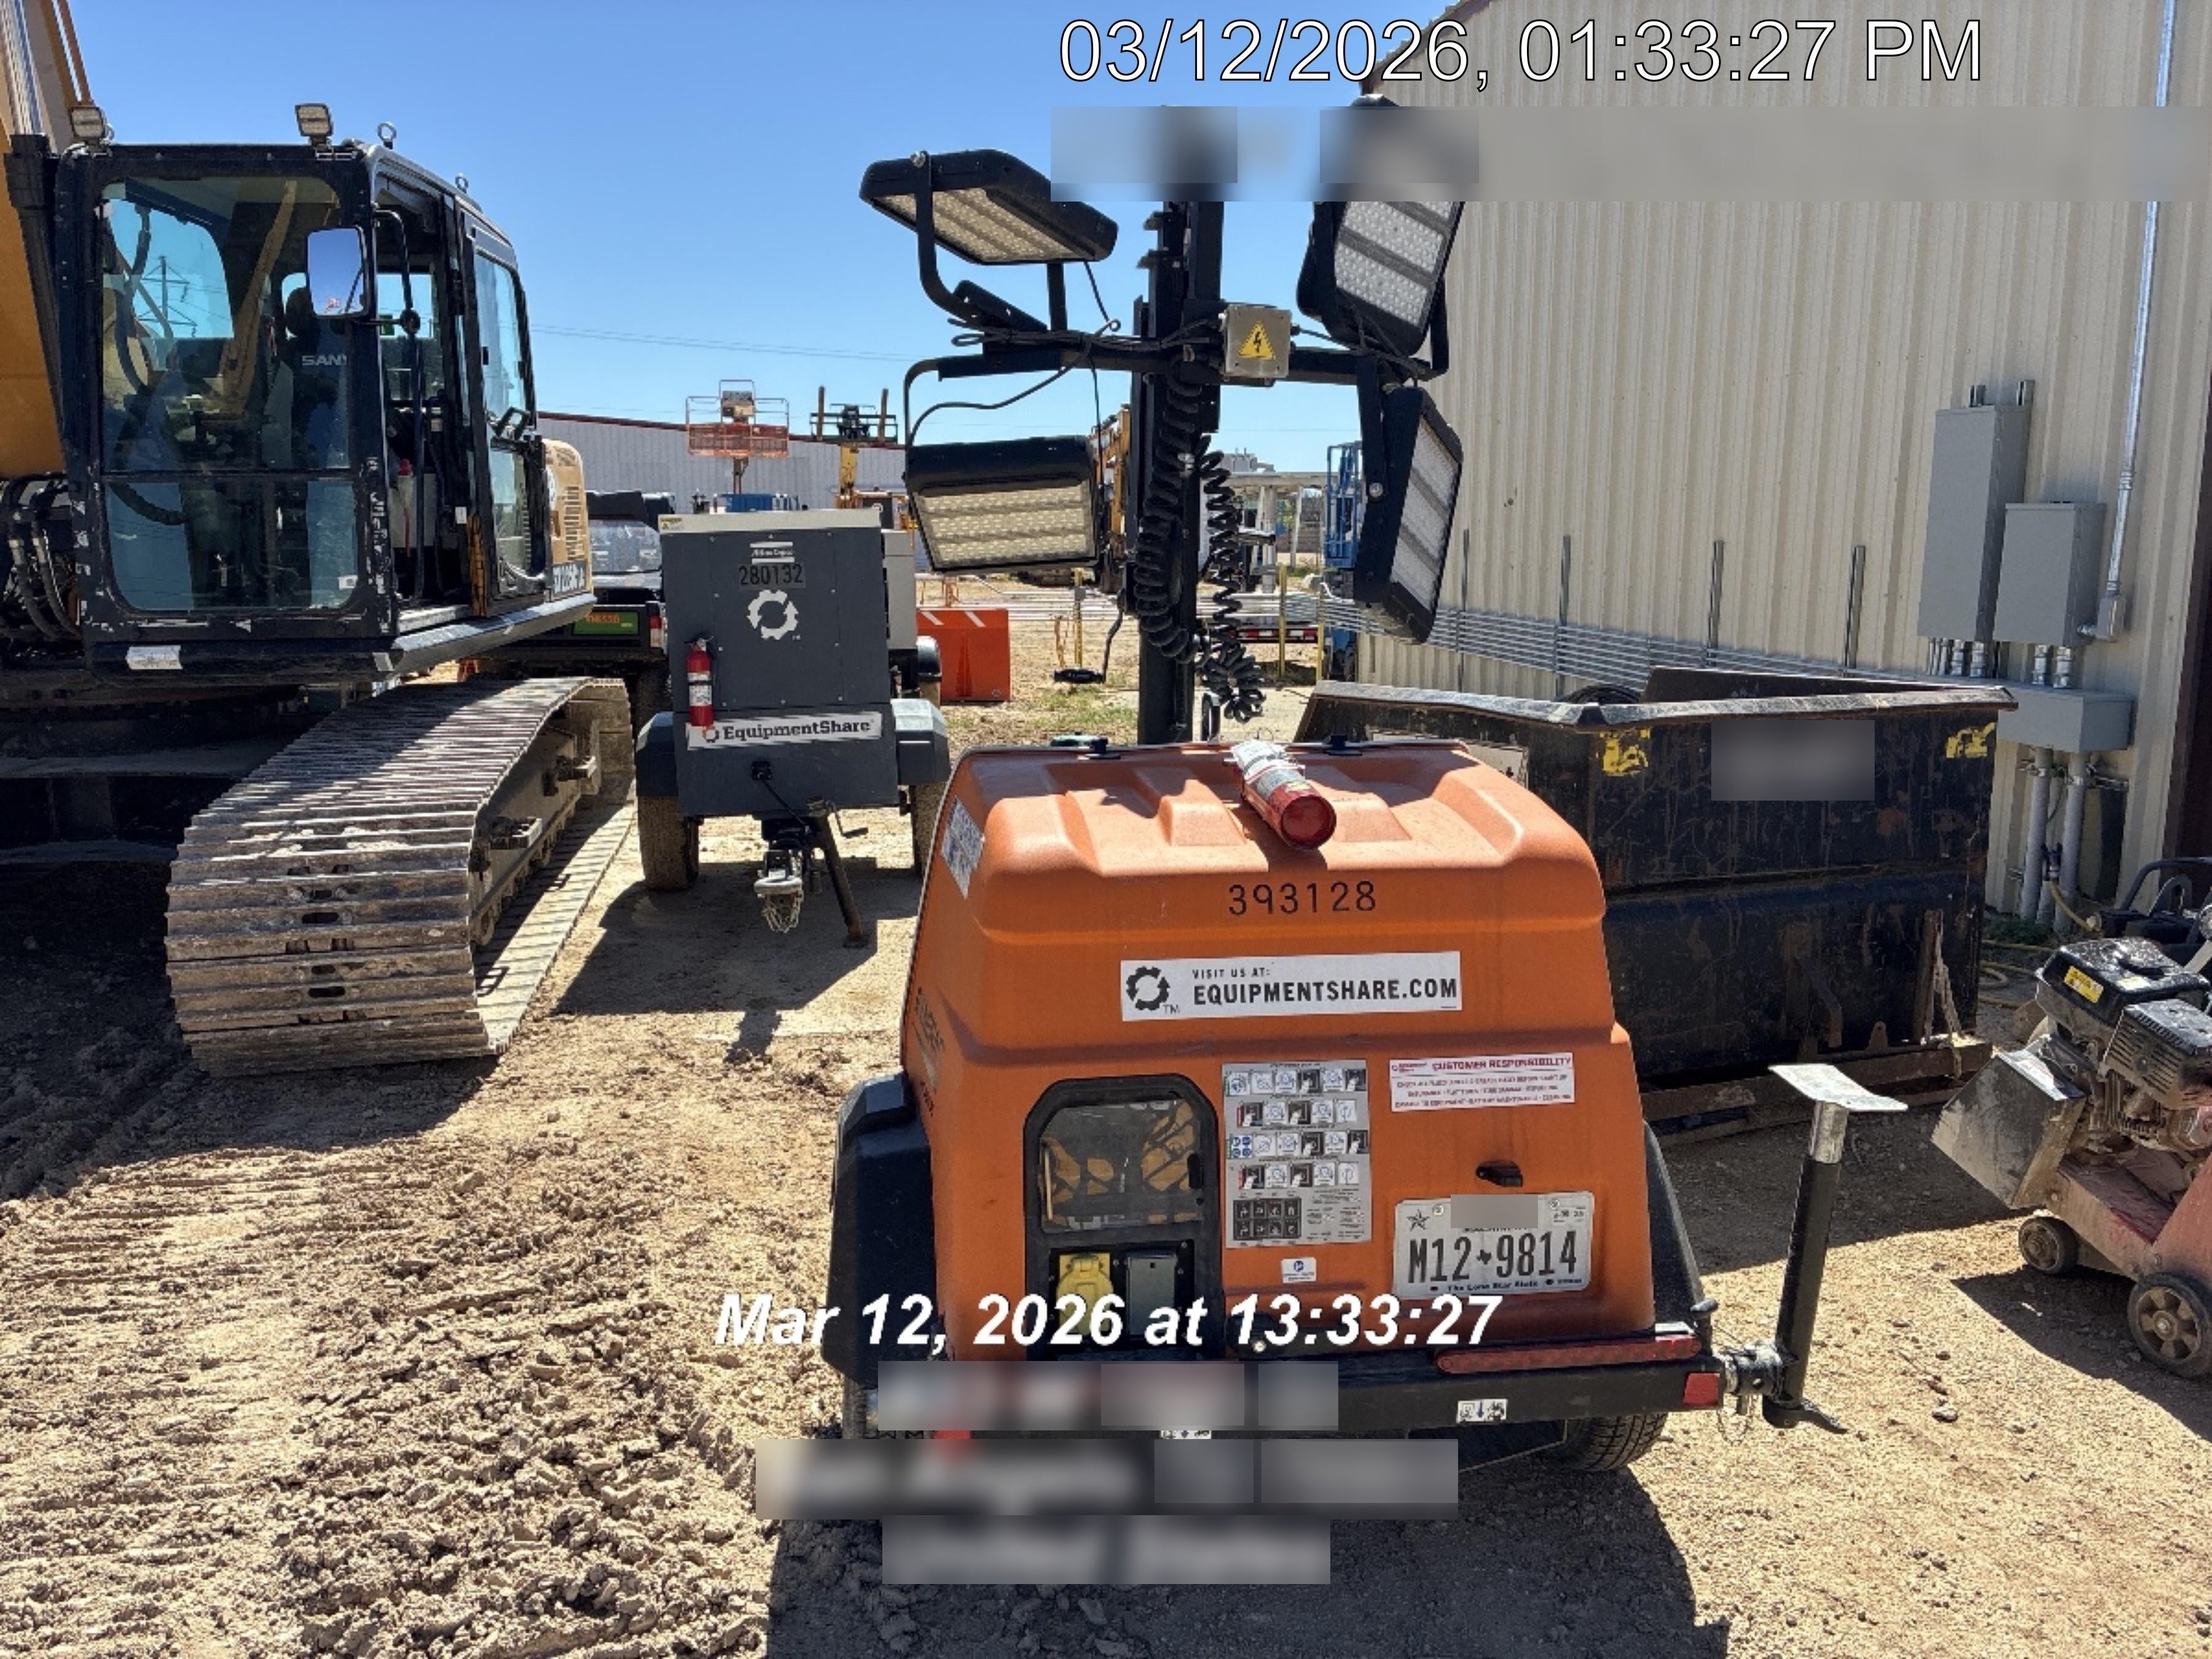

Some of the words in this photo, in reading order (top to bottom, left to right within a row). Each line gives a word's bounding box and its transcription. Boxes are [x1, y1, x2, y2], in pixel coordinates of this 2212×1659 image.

[739, 564, 803, 586] 280132
[723, 720, 871, 741] EquipmentShare
[1228, 880, 1376, 916] 393128
[1192, 969, 1225, 979] VISIT
[1231, 968, 1246, 978] US
[1252, 967, 1271, 977] AT:
[1193, 978, 1457, 1006] EQUIPMENTSHARE.COM
[1408, 1236, 1472, 1283] M12
[1496, 1231, 1577, 1278] 9814
